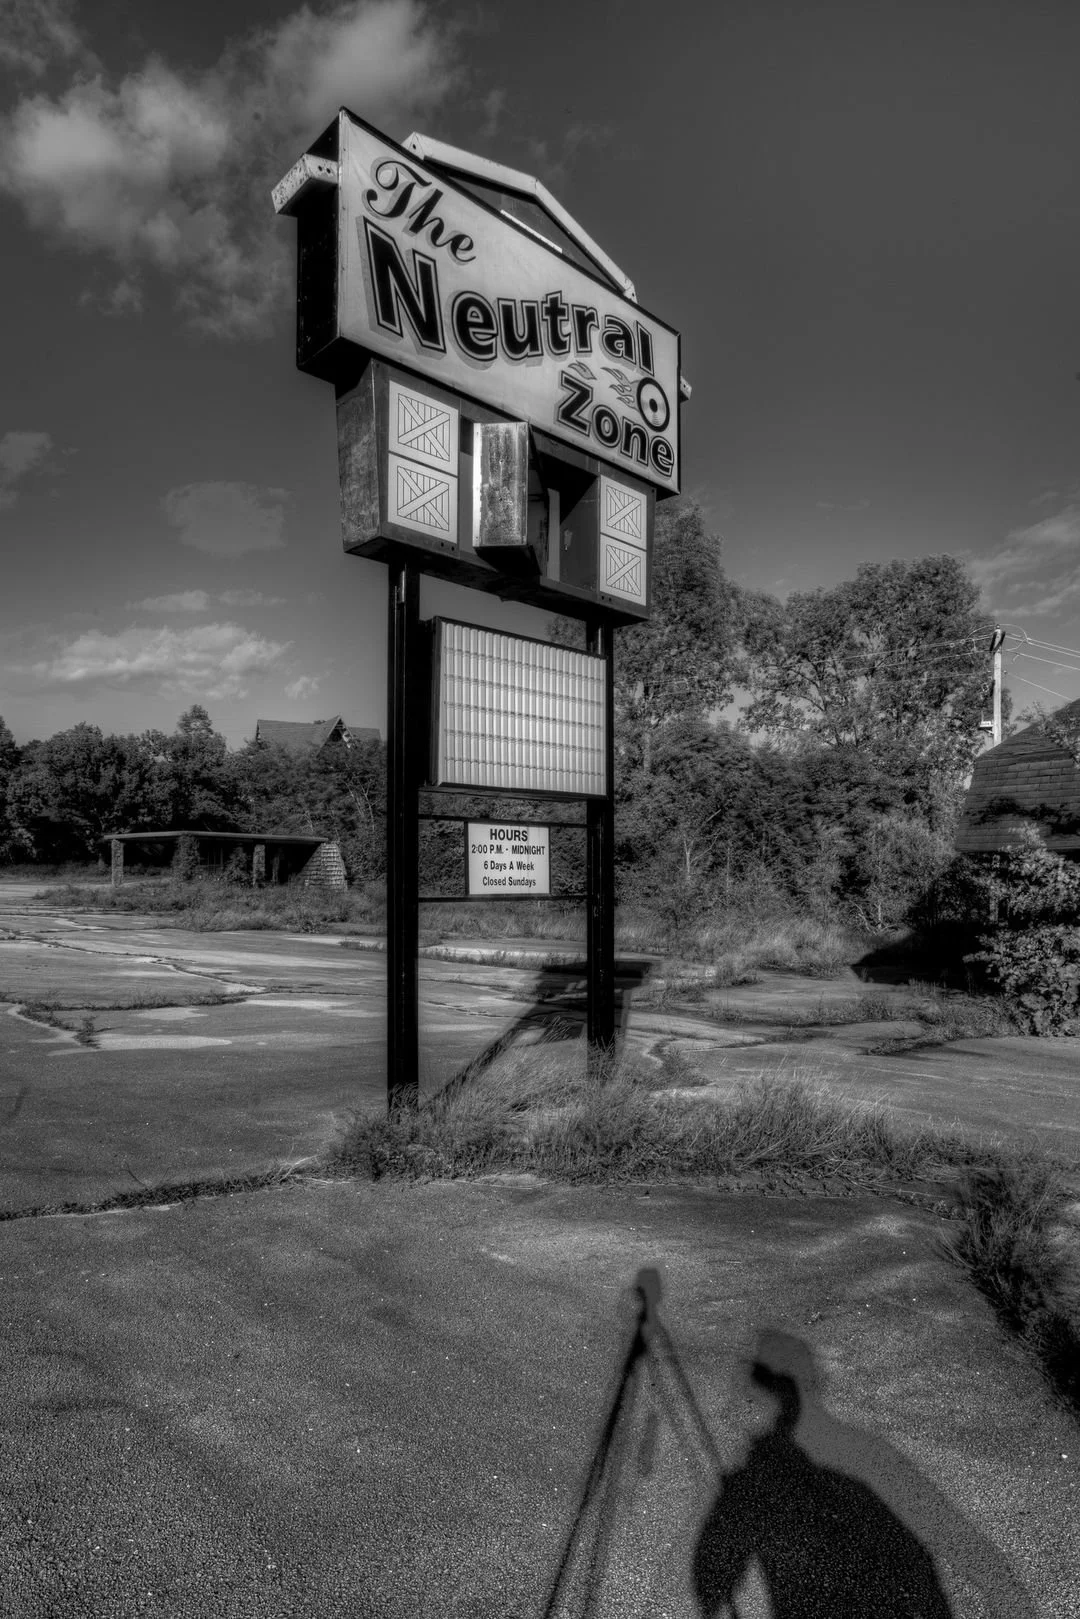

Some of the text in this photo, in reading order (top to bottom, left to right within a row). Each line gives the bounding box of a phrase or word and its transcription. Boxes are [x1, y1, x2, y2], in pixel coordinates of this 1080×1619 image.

[363, 159, 476, 263] The
[360, 215, 655, 376] Neutral
[558, 371, 675, 477] Zone
[490, 828, 528, 842] HOURS
[471, 844, 488, 854] 2:00
[511, 845, 546, 855] MIDNIGHT
[483, 860, 535, 872] 6 Days A Week
[482, 876, 537, 888] Closed Sundays
